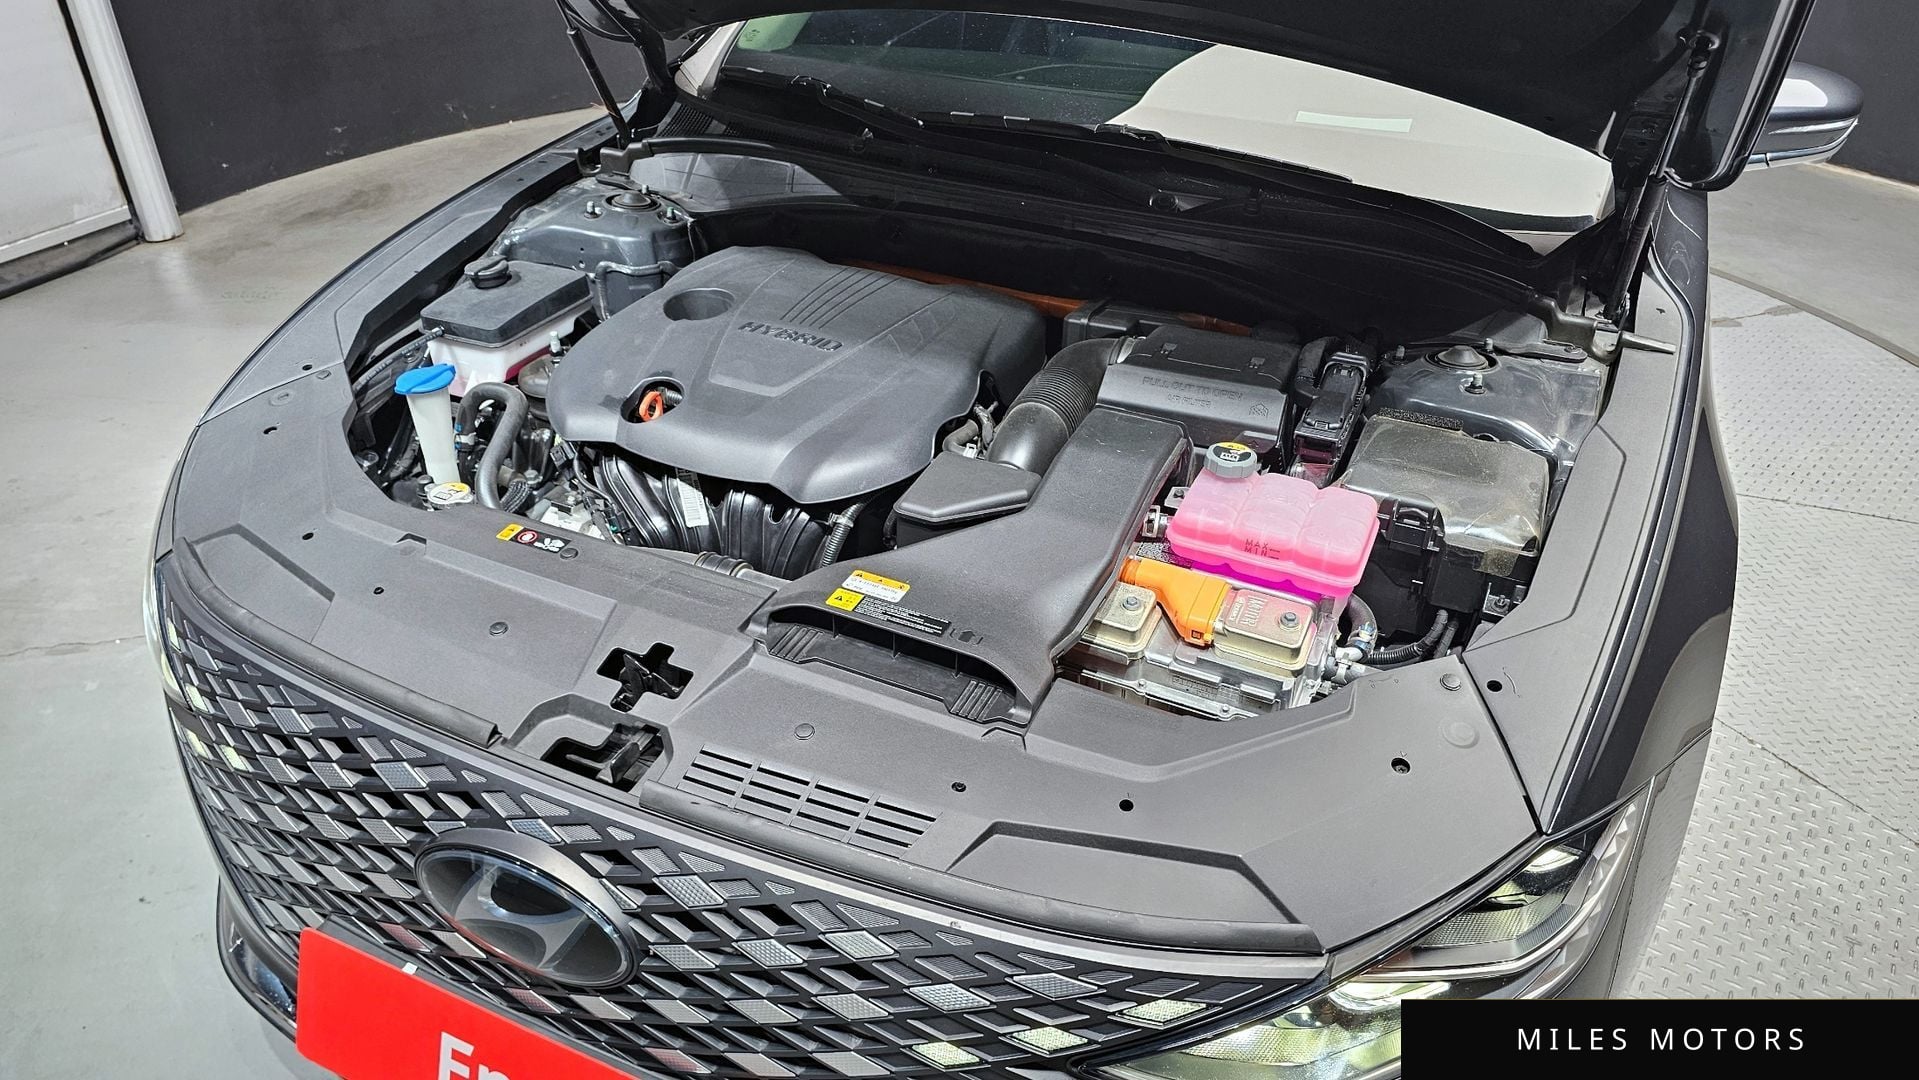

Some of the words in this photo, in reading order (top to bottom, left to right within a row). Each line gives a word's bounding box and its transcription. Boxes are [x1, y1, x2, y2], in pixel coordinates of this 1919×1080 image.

[738, 321, 844, 351] HYBRID
[1142, 376, 1169, 389] PULL
[1245, 539, 1269, 550] MAX
[1244, 546, 1268, 557] MIN
